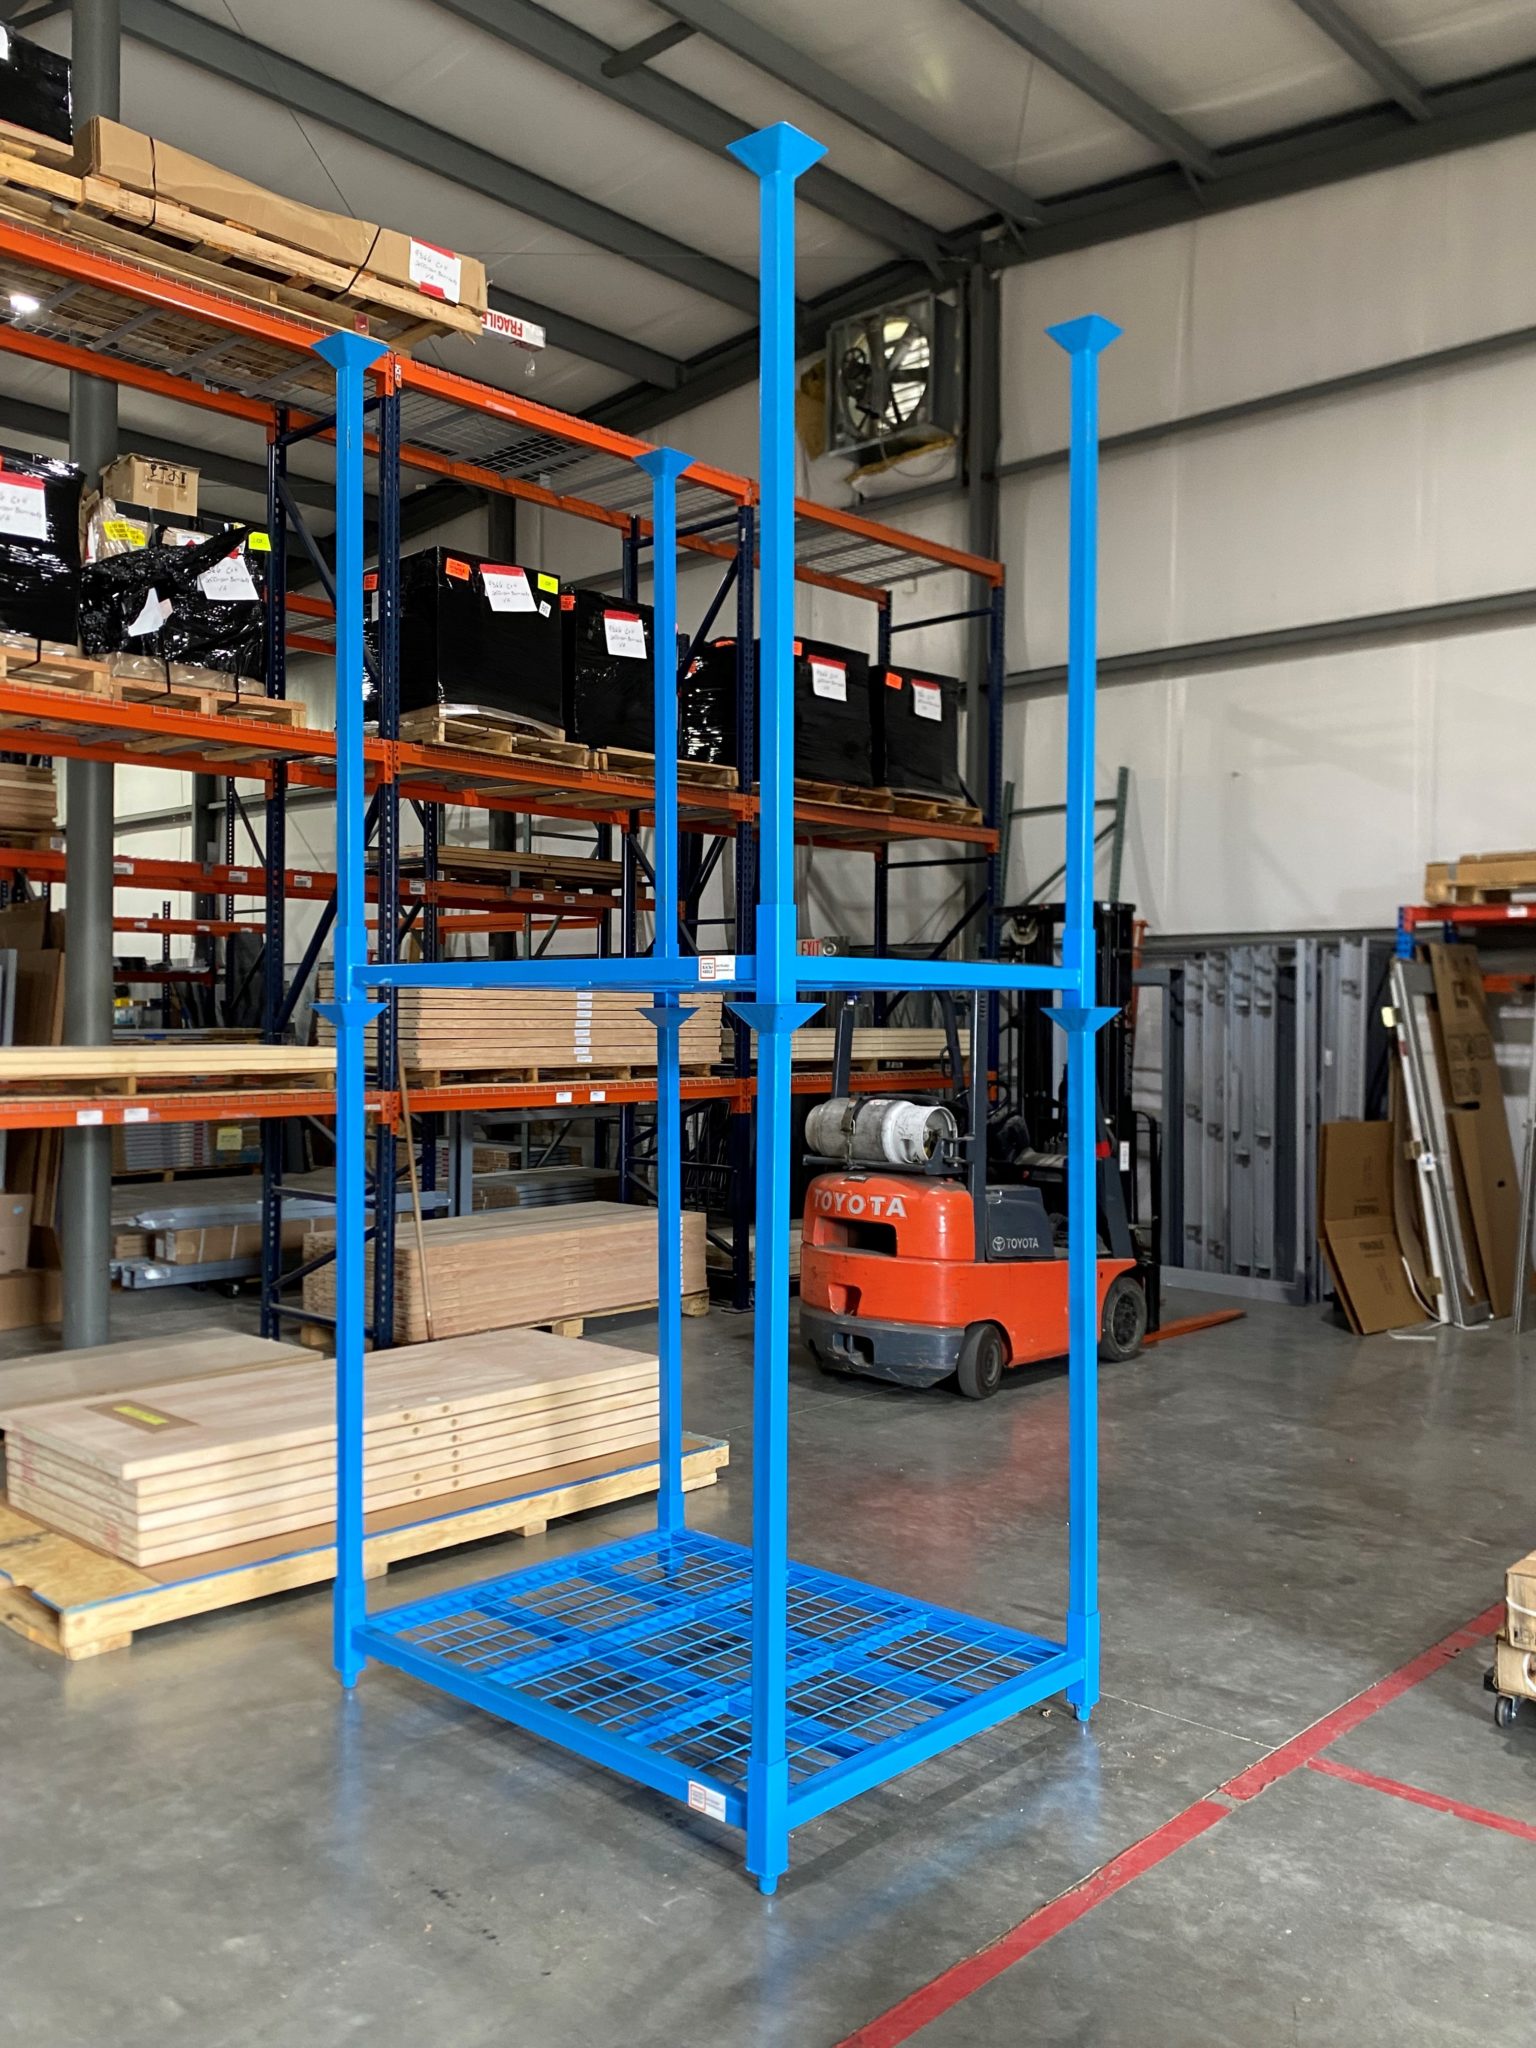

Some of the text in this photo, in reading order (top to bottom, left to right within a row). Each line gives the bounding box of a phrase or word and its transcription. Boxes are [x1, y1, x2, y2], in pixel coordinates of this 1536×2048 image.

[481, 311, 523, 337] FRAGILE
[801, 940, 820, 956] EXIT
[814, 1188, 907, 1218] TOYOTA
[1006, 1237, 1039, 1249] TOYOTA
